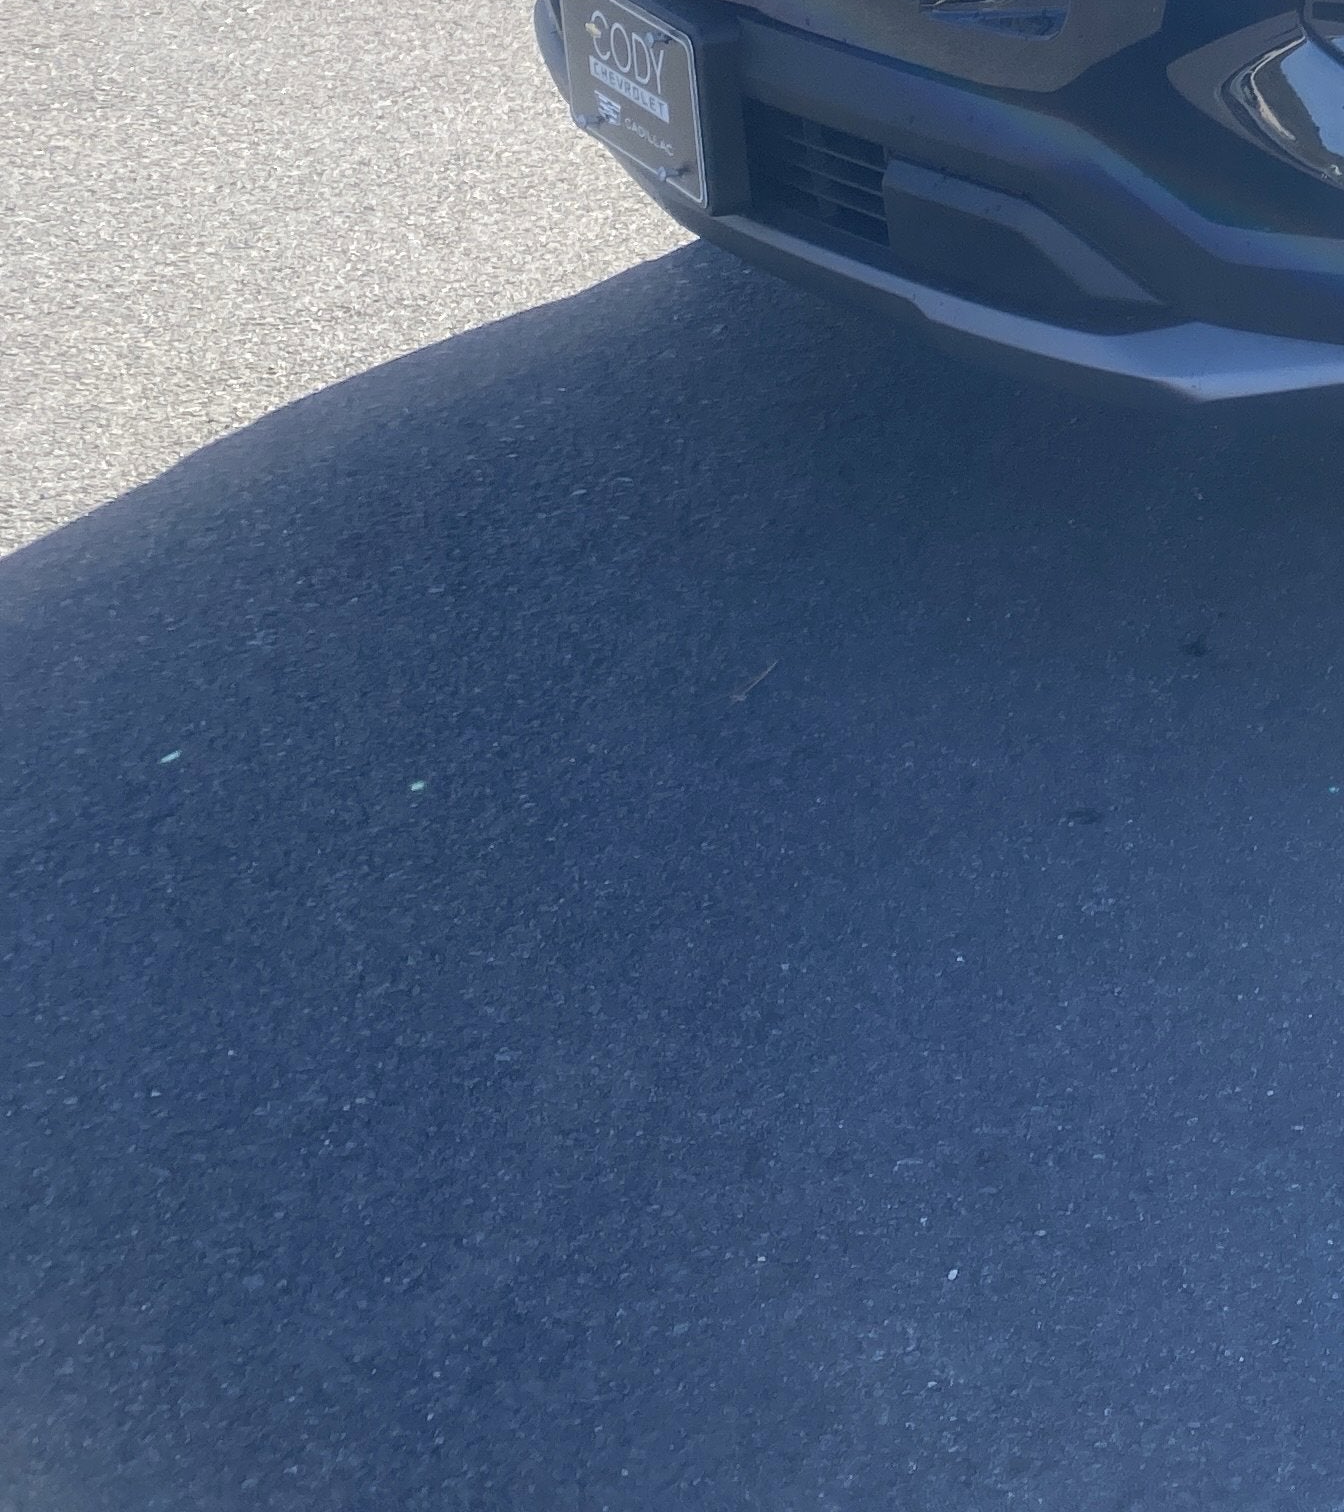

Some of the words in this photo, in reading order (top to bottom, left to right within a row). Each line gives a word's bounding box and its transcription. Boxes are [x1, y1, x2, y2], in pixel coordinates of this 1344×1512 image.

[591, 10, 665, 95] CODY
[592, 61, 667, 119] CHEVROLET
[624, 117, 674, 157] CADILLAC
